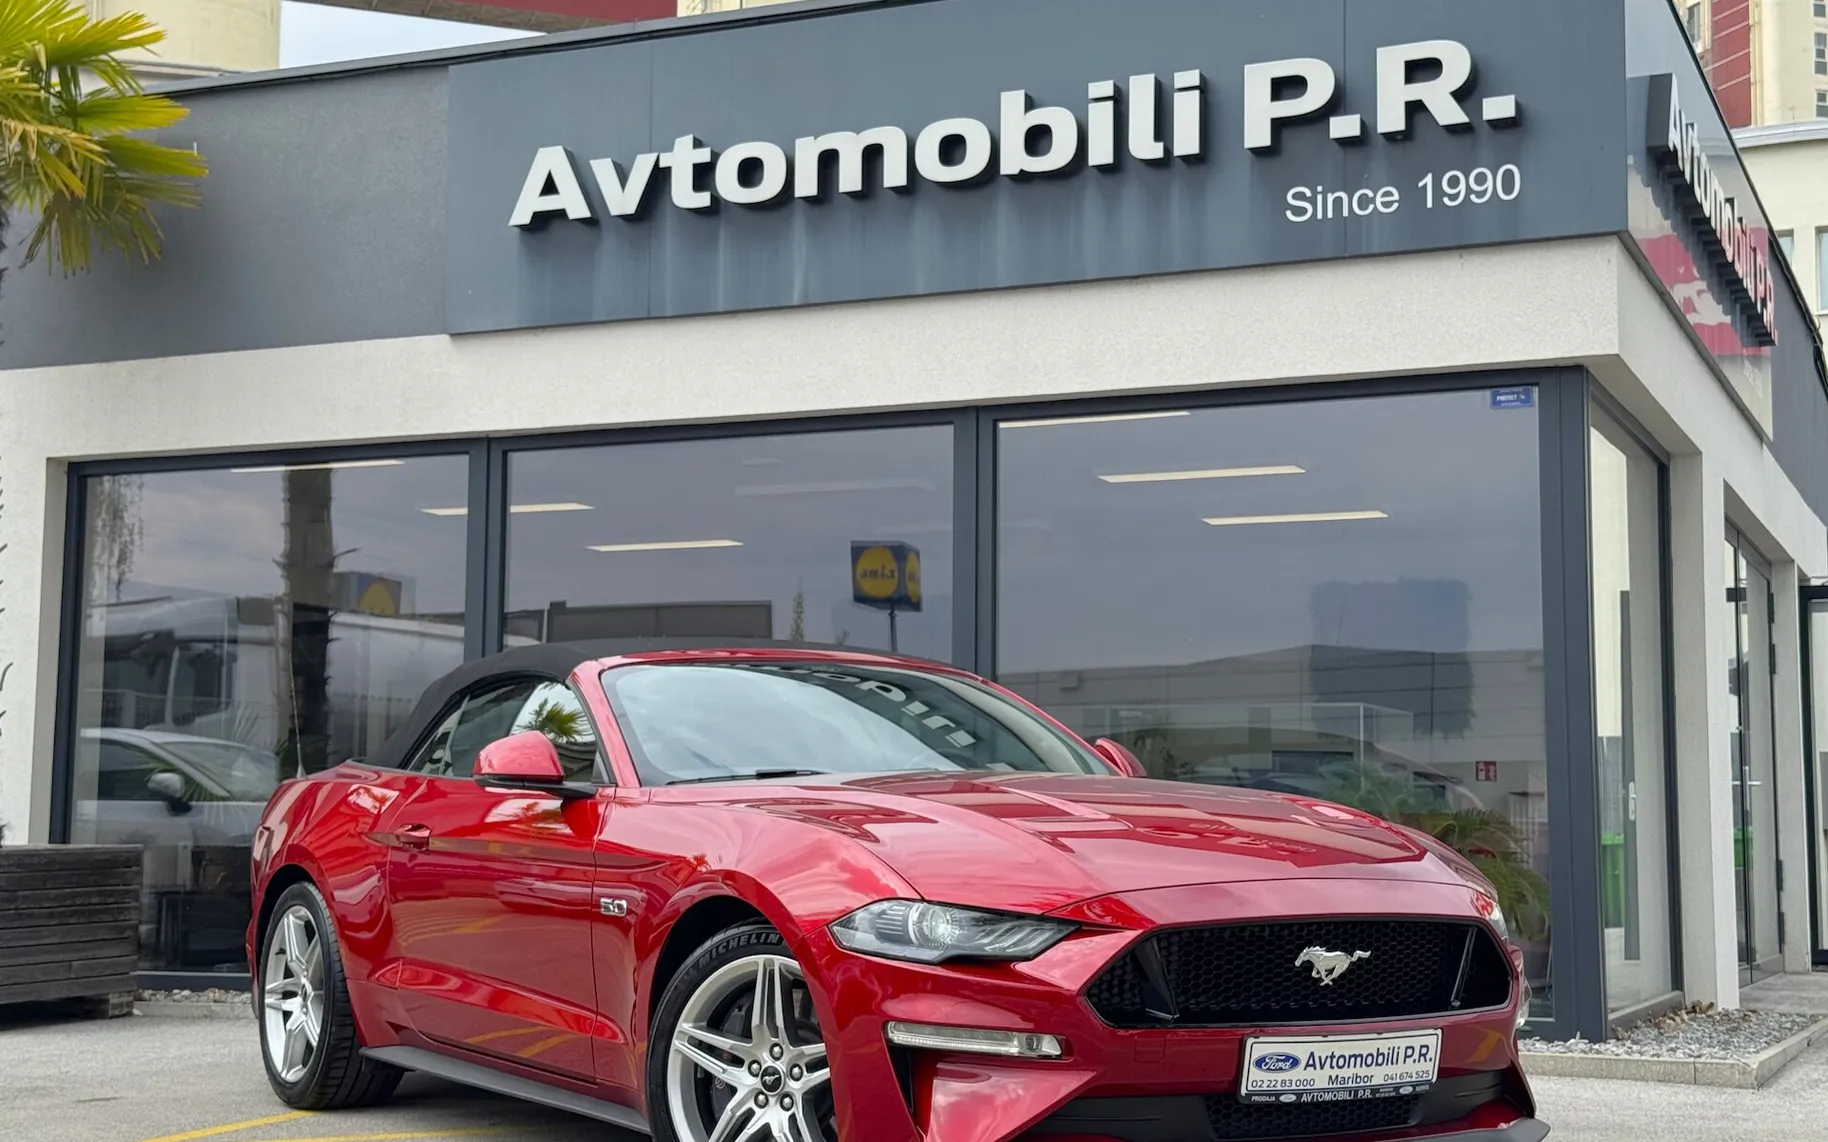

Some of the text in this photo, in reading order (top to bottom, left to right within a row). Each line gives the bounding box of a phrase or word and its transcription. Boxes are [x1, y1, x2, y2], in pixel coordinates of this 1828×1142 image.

[508, 39, 1518, 227] Avtomobili P.R.
[1285, 163, 1522, 222] Since 1990
[700, 933, 780, 968] MICHELIN
[1303, 1044, 1433, 1071] Avtomobili P.R.
[1251, 1070, 1430, 1088] 02 22 83 000 Maribor 041 674 525
[1301, 1090, 1354, 1103] AVTOMOBILI
[1358, 1089, 1373, 1099] P.R.
